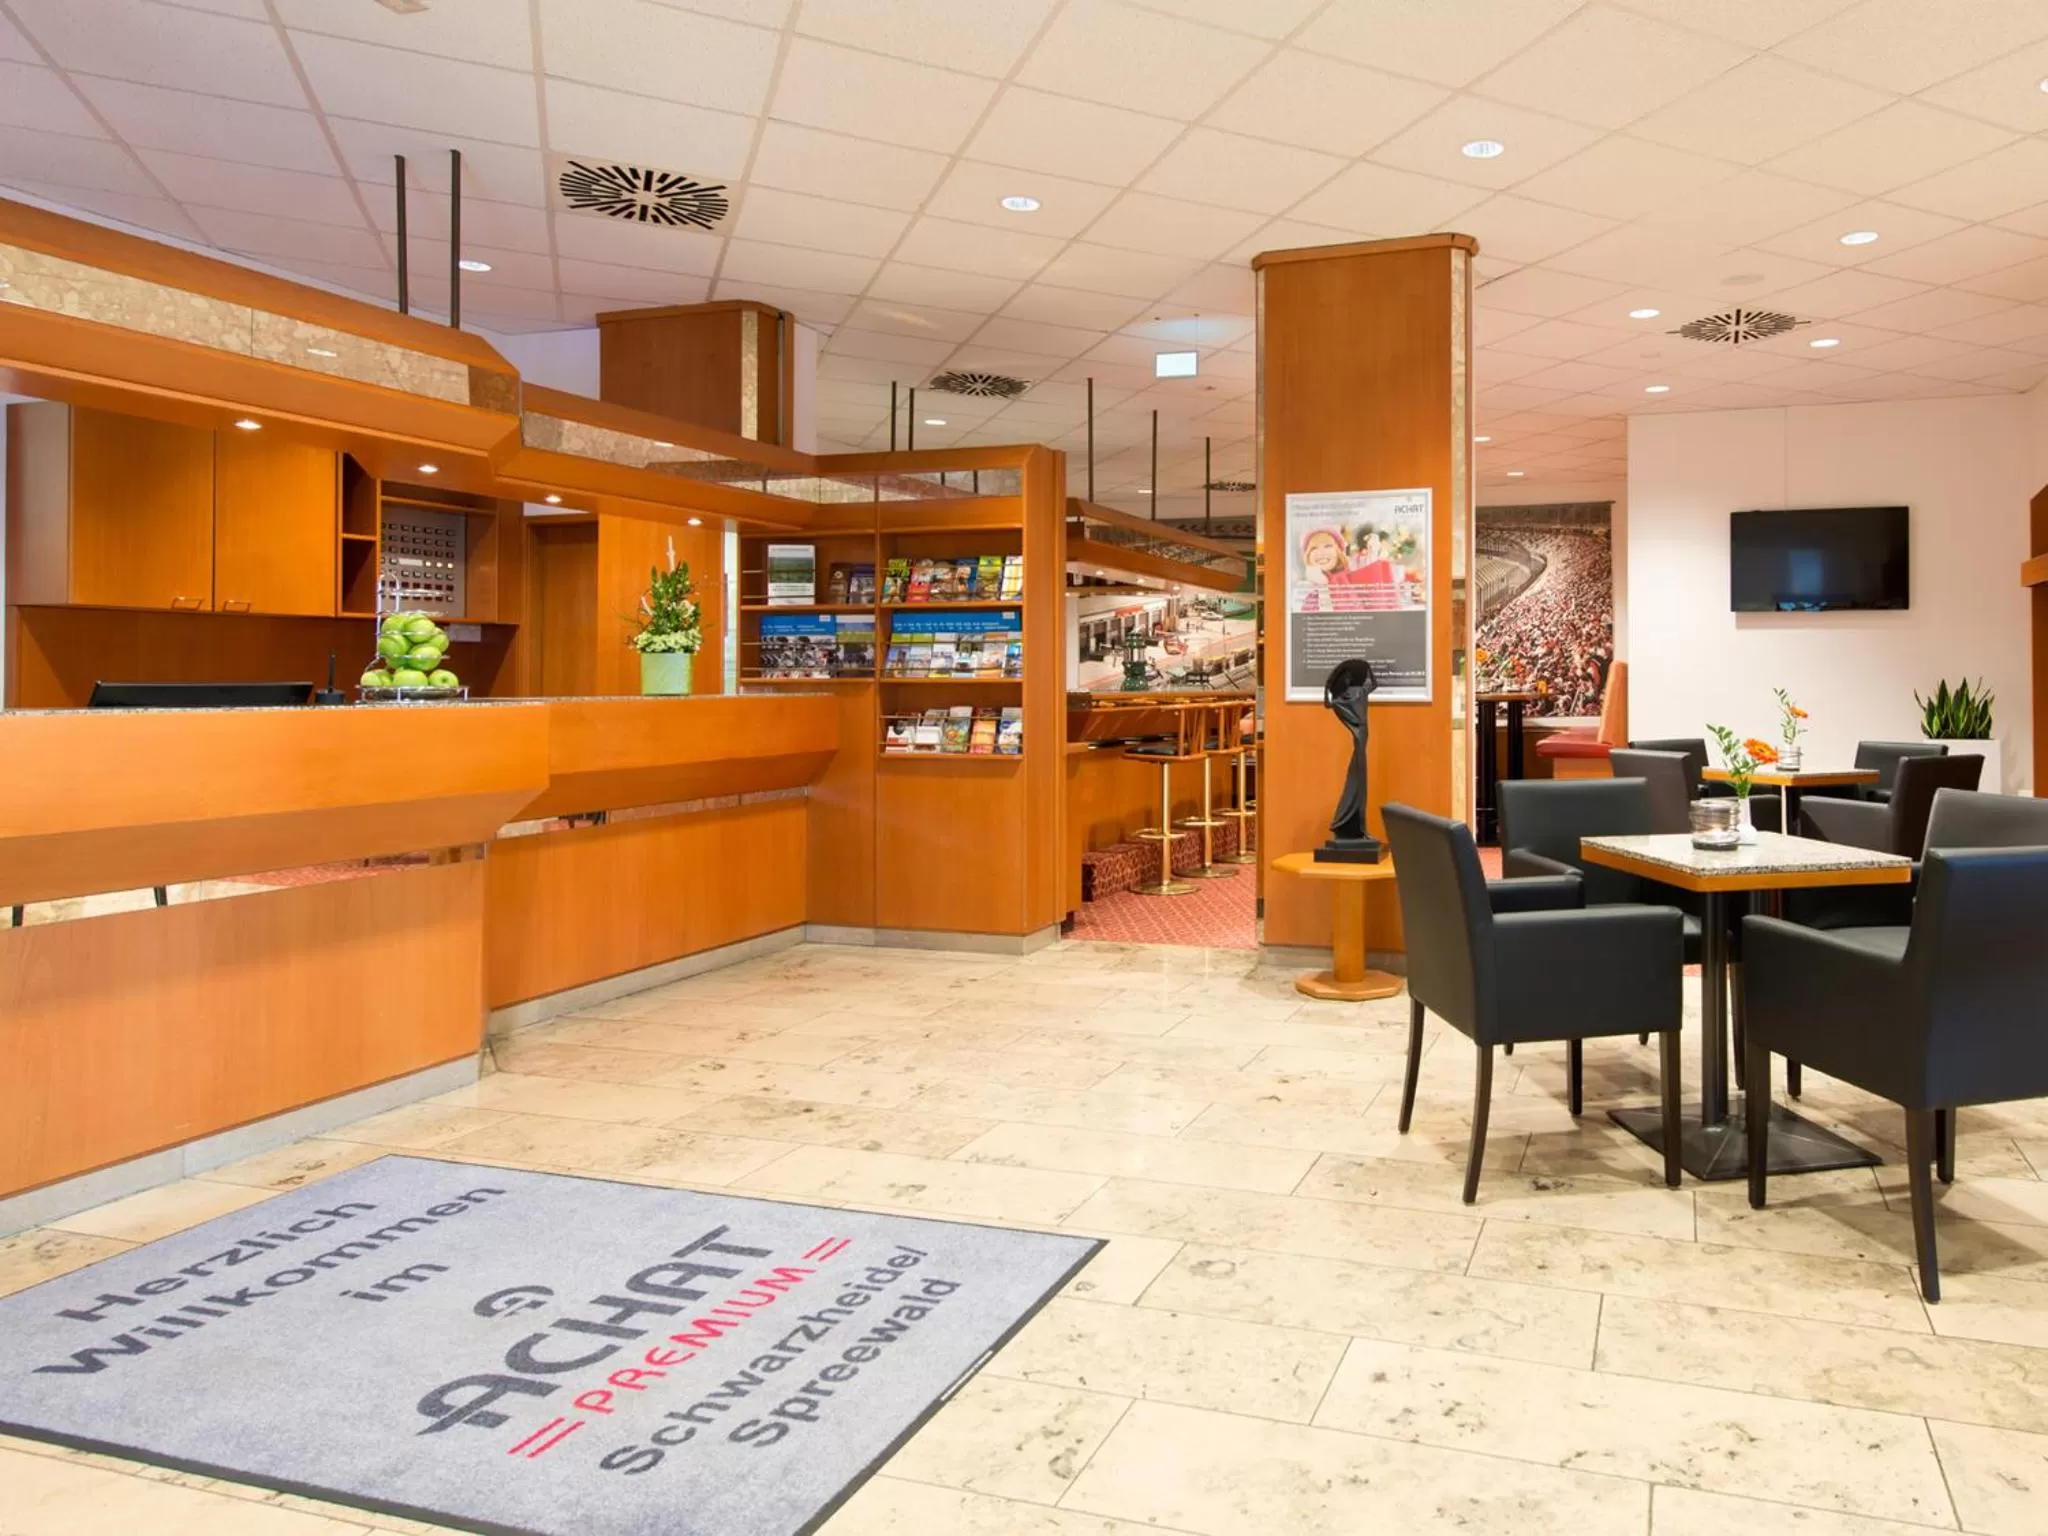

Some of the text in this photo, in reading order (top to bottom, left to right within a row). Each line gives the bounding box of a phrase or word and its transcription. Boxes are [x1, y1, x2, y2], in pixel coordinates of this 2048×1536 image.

[32, 1183, 506, 1375] Willkommen
[55, 1200, 379, 1322] Herzlich
[338, 1262, 451, 1303] im
[416, 1224, 774, 1436] ACHAT
[572, 1266, 817, 1415] PREMIUM
[599, 1245, 929, 1476] Schwarzheide/
[728, 1278, 961, 1448] Spreewald
